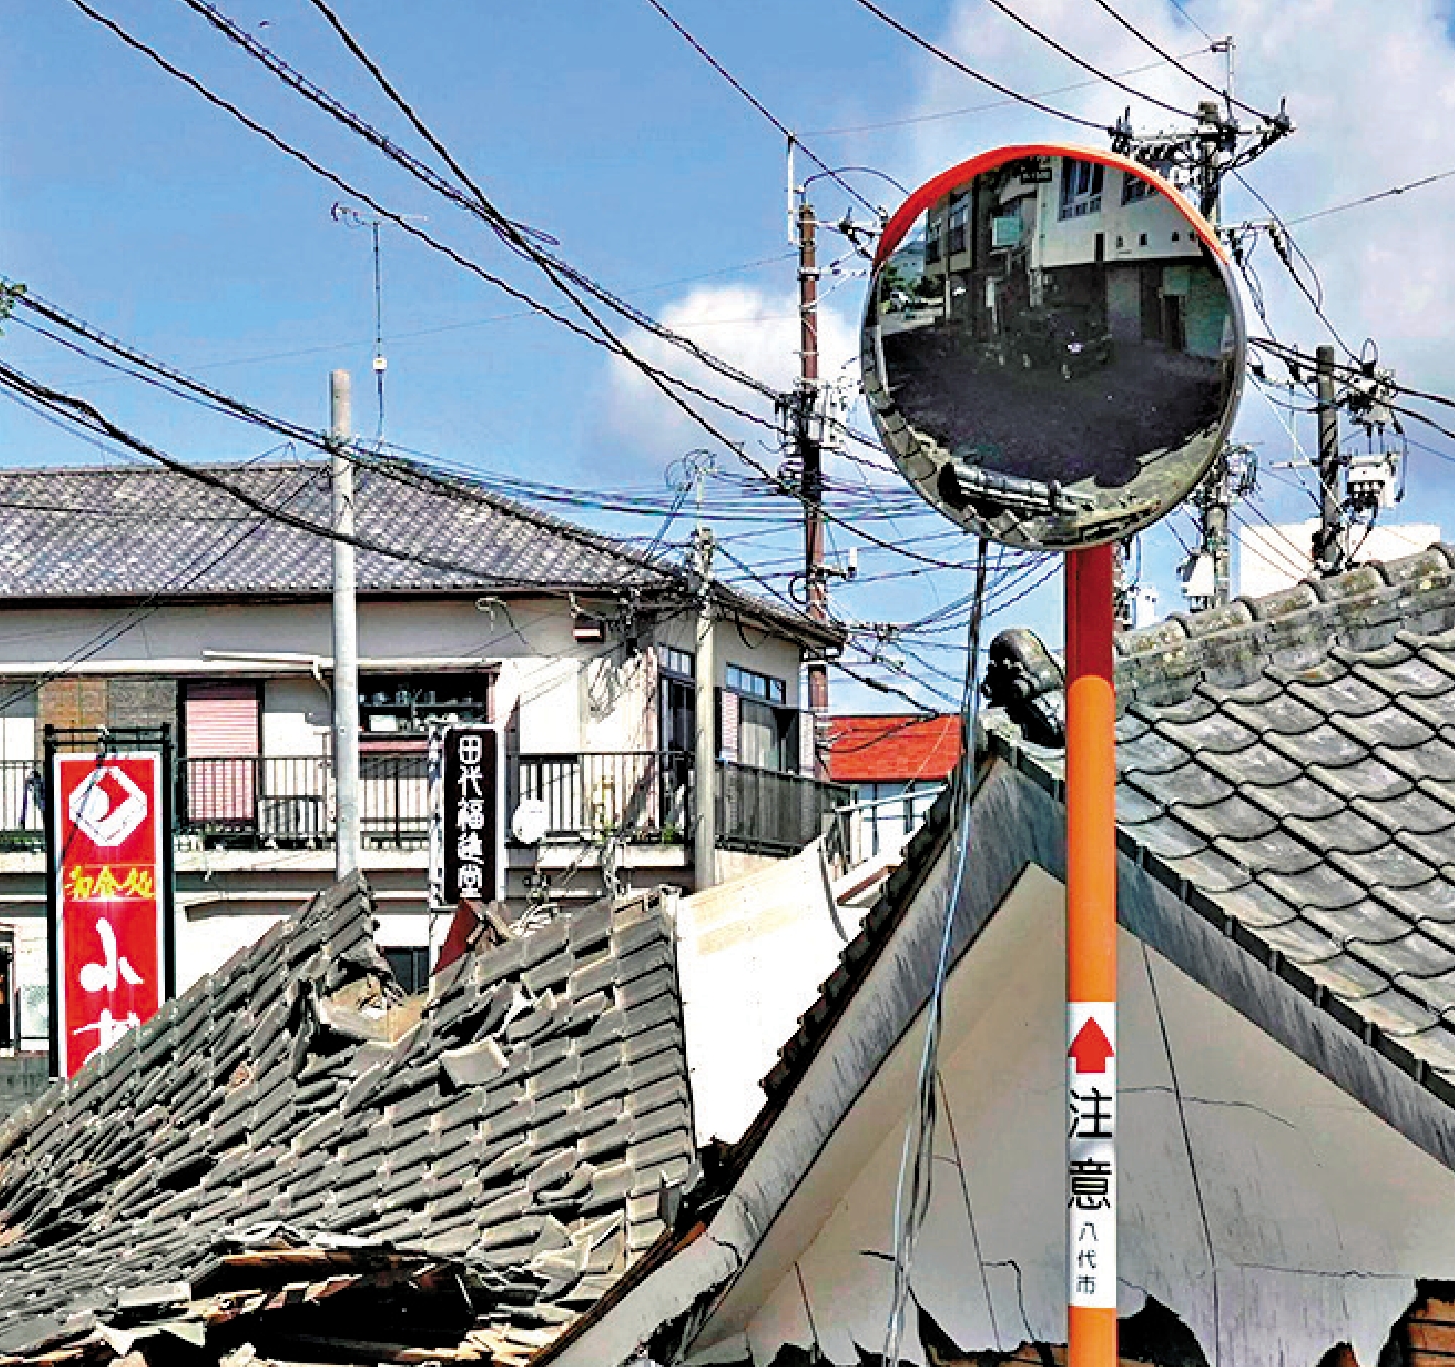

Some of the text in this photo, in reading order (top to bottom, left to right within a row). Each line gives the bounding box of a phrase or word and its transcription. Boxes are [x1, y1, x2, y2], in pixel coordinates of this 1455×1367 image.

[1068, 1086, 1113, 1209] 注意
[1076, 1220, 1099, 1295] 八代市
